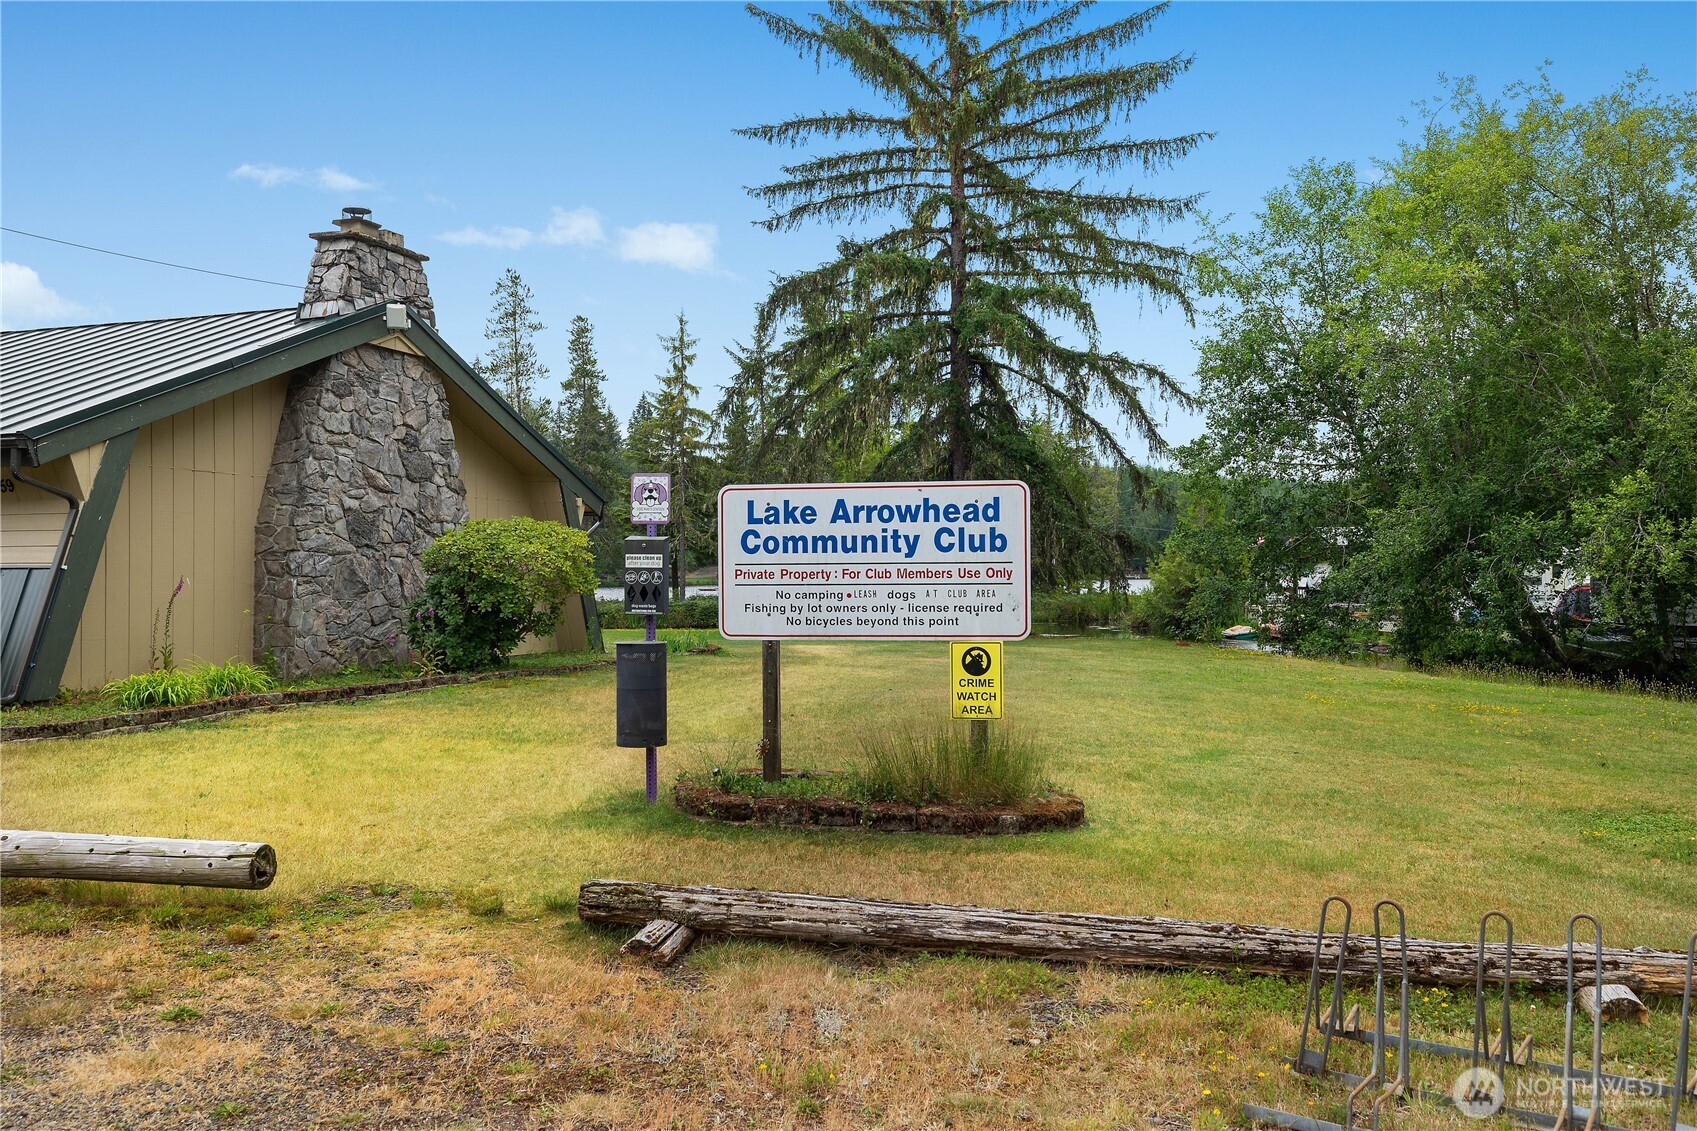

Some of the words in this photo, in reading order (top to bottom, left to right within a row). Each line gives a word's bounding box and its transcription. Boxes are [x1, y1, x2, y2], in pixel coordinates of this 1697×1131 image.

[747, 499, 818, 525] Lake
[829, 496, 1000, 525] Arrowhead
[740, 528, 921, 559] Community
[933, 526, 1008, 553] Club
[734, 569, 775, 580] Private
[842, 568, 861, 579] For
[865, 568, 892, 579] Club
[896, 568, 953, 579] Members
[957, 567, 981, 579] Use
[985, 567, 1013, 580] Only
[775, 590, 792, 600] No
[794, 590, 844, 602] camping
[853, 590, 877, 599] LEASH
[887, 590, 916, 602] dogs
[947, 589, 968, 598] CLUB
[976, 589, 997, 598] AREA
[744, 603, 786, 615] Fishing
[790, 603, 804, 615] by
[807, 603, 822, 613] lot
[825, 604, 868, 613] owners
[871, 603, 896, 615] only
[907, 602, 950, 613] license
[953, 602, 1003, 615] required
[786, 617, 802, 626] No
[805, 616, 853, 628] bicycles
[856, 616, 899, 628] beyond
[902, 616, 925, 626] this
[928, 616, 960, 628] point
[958, 678, 995, 688] CRIME
[956, 691, 997, 701] WATCH
[960, 705, 993, 715] AREA
